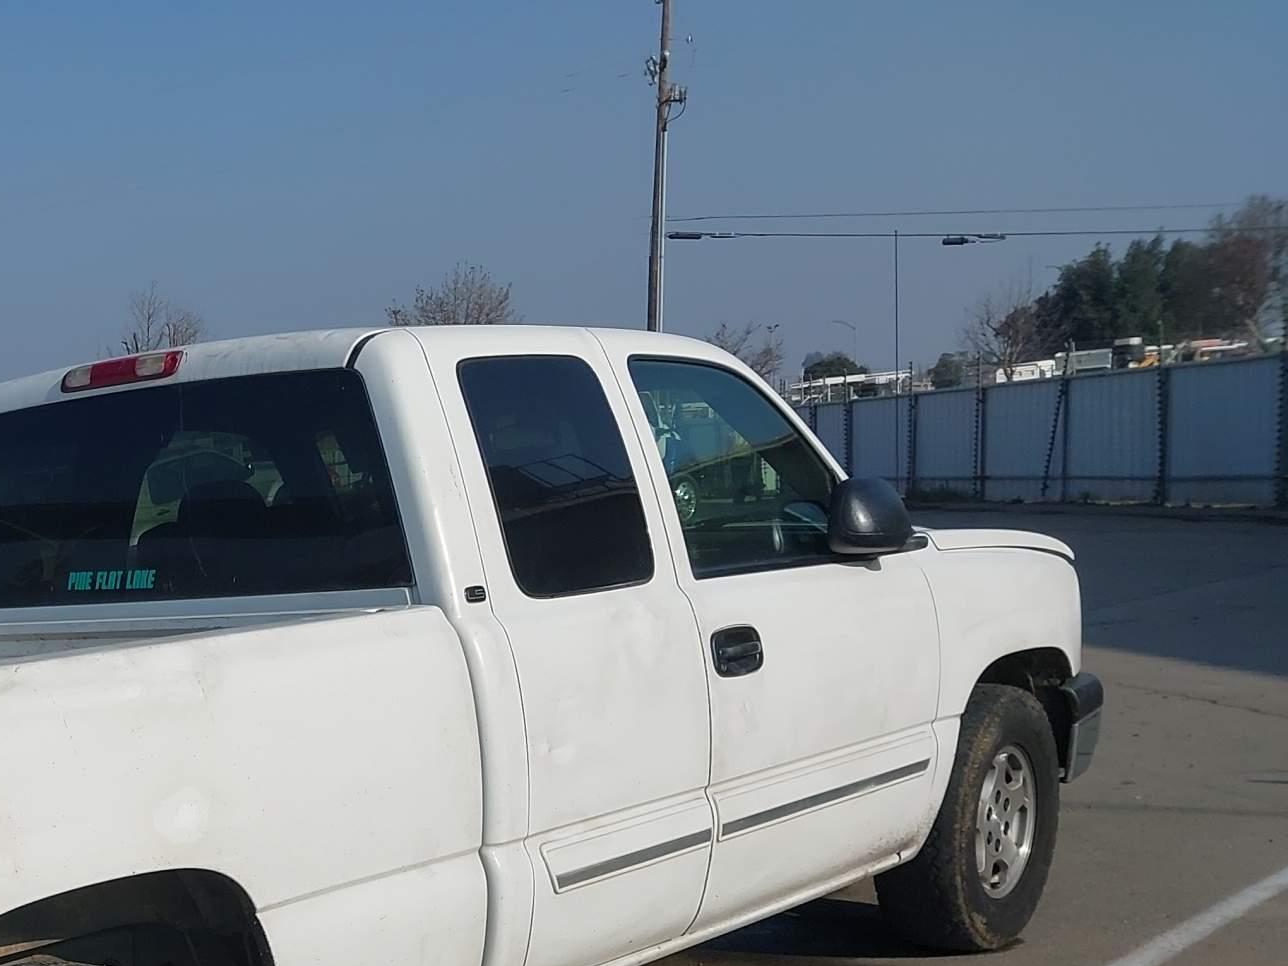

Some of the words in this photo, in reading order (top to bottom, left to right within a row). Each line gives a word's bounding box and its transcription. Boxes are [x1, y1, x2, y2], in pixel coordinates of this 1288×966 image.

[67, 572, 94, 591] PINE
[95, 570, 124, 590] FLAT
[125, 569, 157, 589] LAKE
[466, 588, 485, 600] LS
